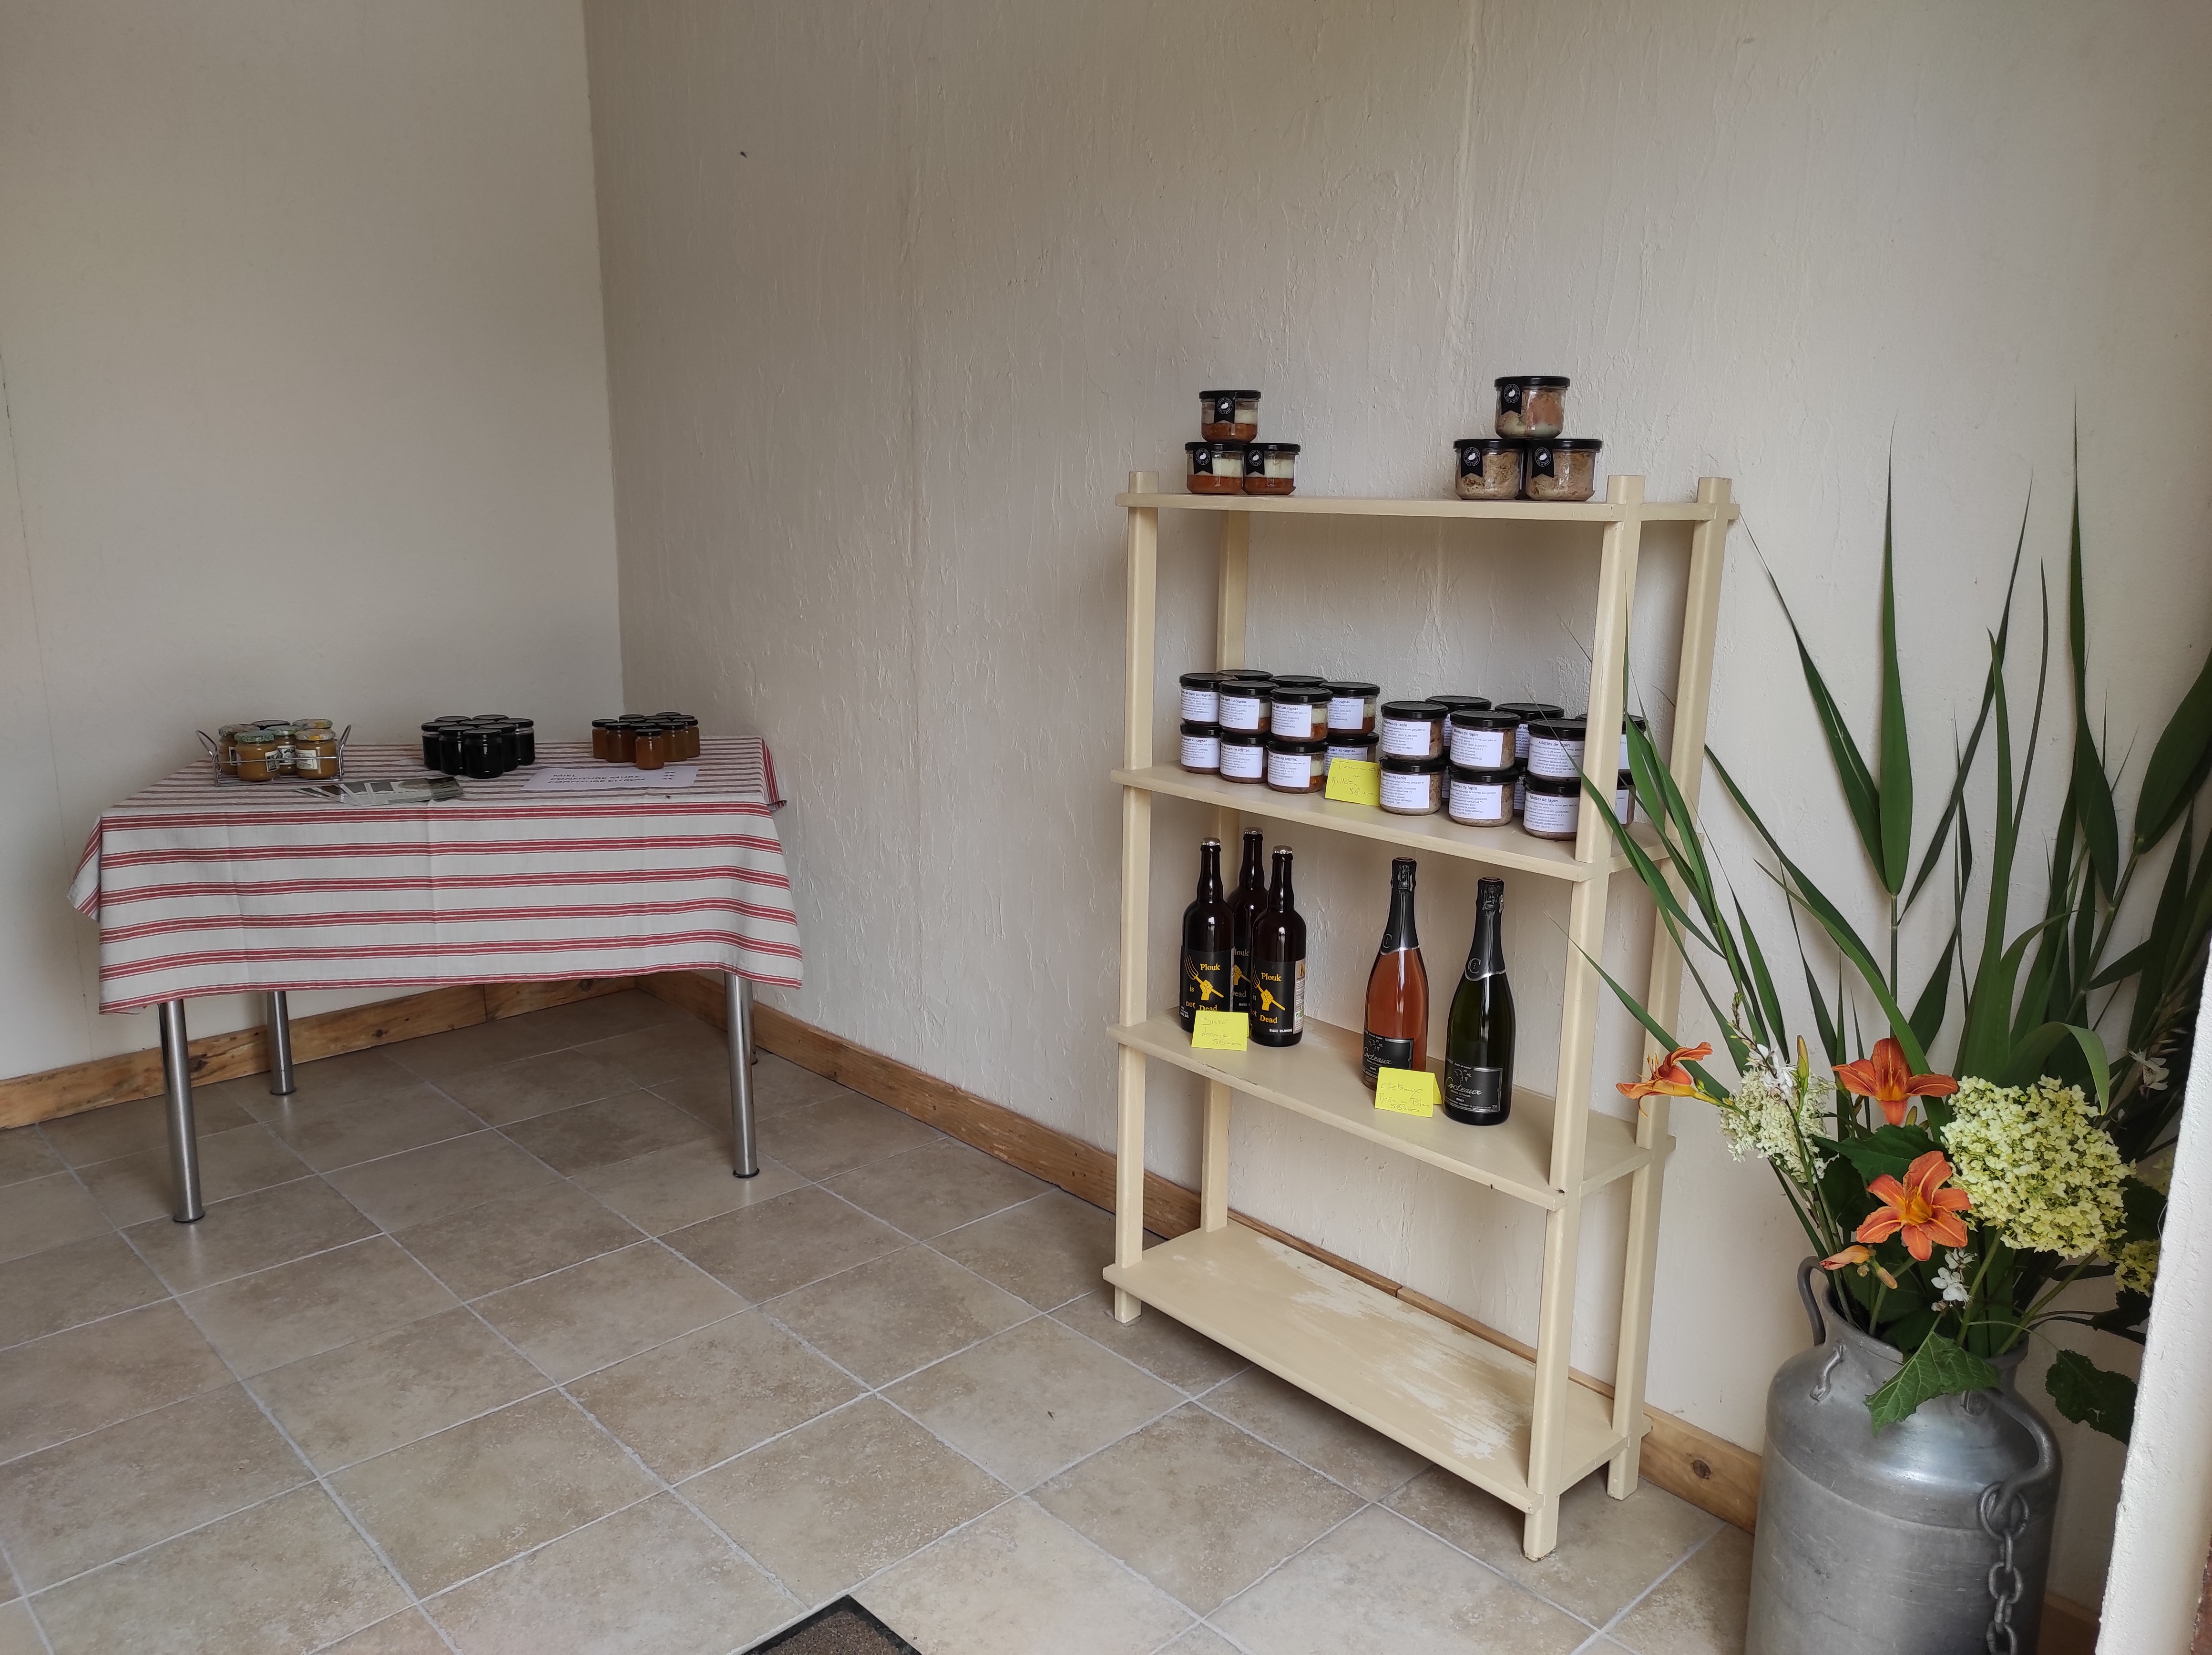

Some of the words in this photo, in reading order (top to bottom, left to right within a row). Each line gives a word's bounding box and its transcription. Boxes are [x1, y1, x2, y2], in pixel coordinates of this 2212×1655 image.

[1235, 948, 1249, 957] louk
[1199, 962, 1221, 971] Plouk
[1261, 972, 1282, 982] Plouk
[1189, 984, 1195, 992] is
[1253, 992, 1257, 1001] is
[1186, 1001, 1196, 1009] not
[1259, 1014, 1278, 1024] Dead
[1363, 1046, 1393, 1065] Cocteaux
[1446, 1077, 1483, 1095] Cocteaux
